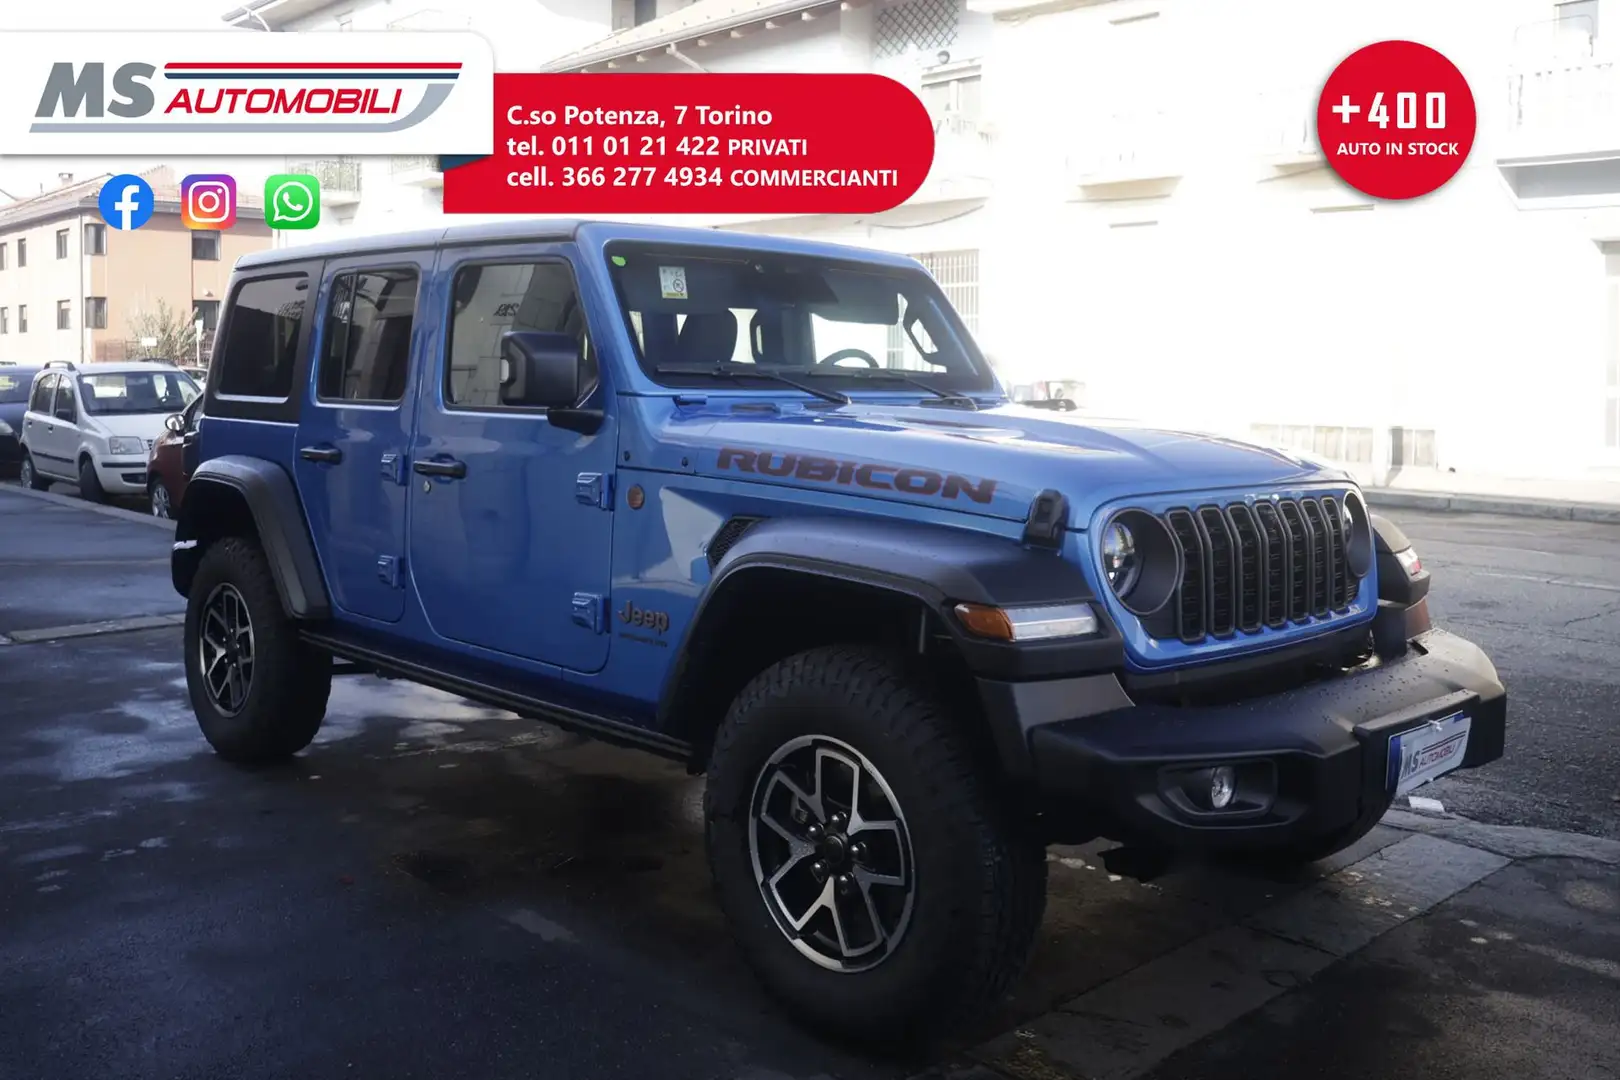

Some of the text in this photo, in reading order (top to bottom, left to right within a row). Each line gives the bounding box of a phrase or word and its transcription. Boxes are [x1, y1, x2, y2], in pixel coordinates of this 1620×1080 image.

[716, 447, 998, 505] RUBICON
[616, 599, 670, 636] Jeep
[1400, 750, 1420, 780] MS
